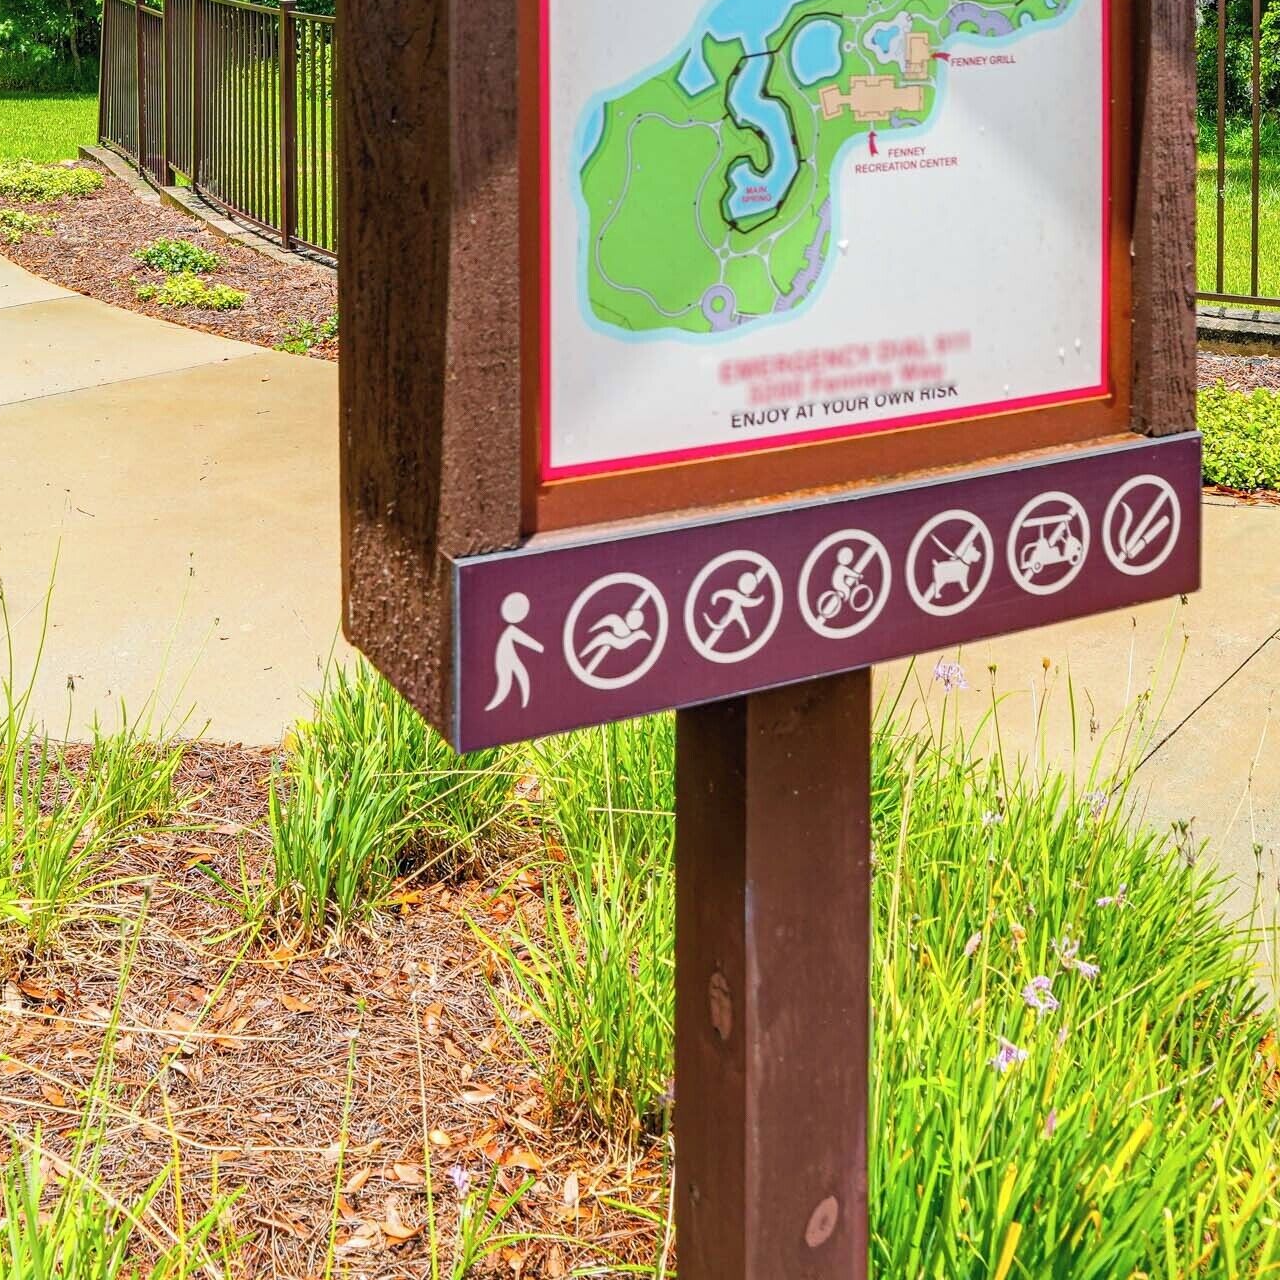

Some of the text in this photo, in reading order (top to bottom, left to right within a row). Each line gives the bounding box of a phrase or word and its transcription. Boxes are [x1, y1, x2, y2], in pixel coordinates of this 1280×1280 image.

[951, 55, 1016, 67] FENNEY GRILL
[887, 146, 926, 158] FENNEY
[854, 156, 958, 174] RECREATION CENTER
[731, 382, 958, 428] ENJOY AT YOUR OWN RISK
